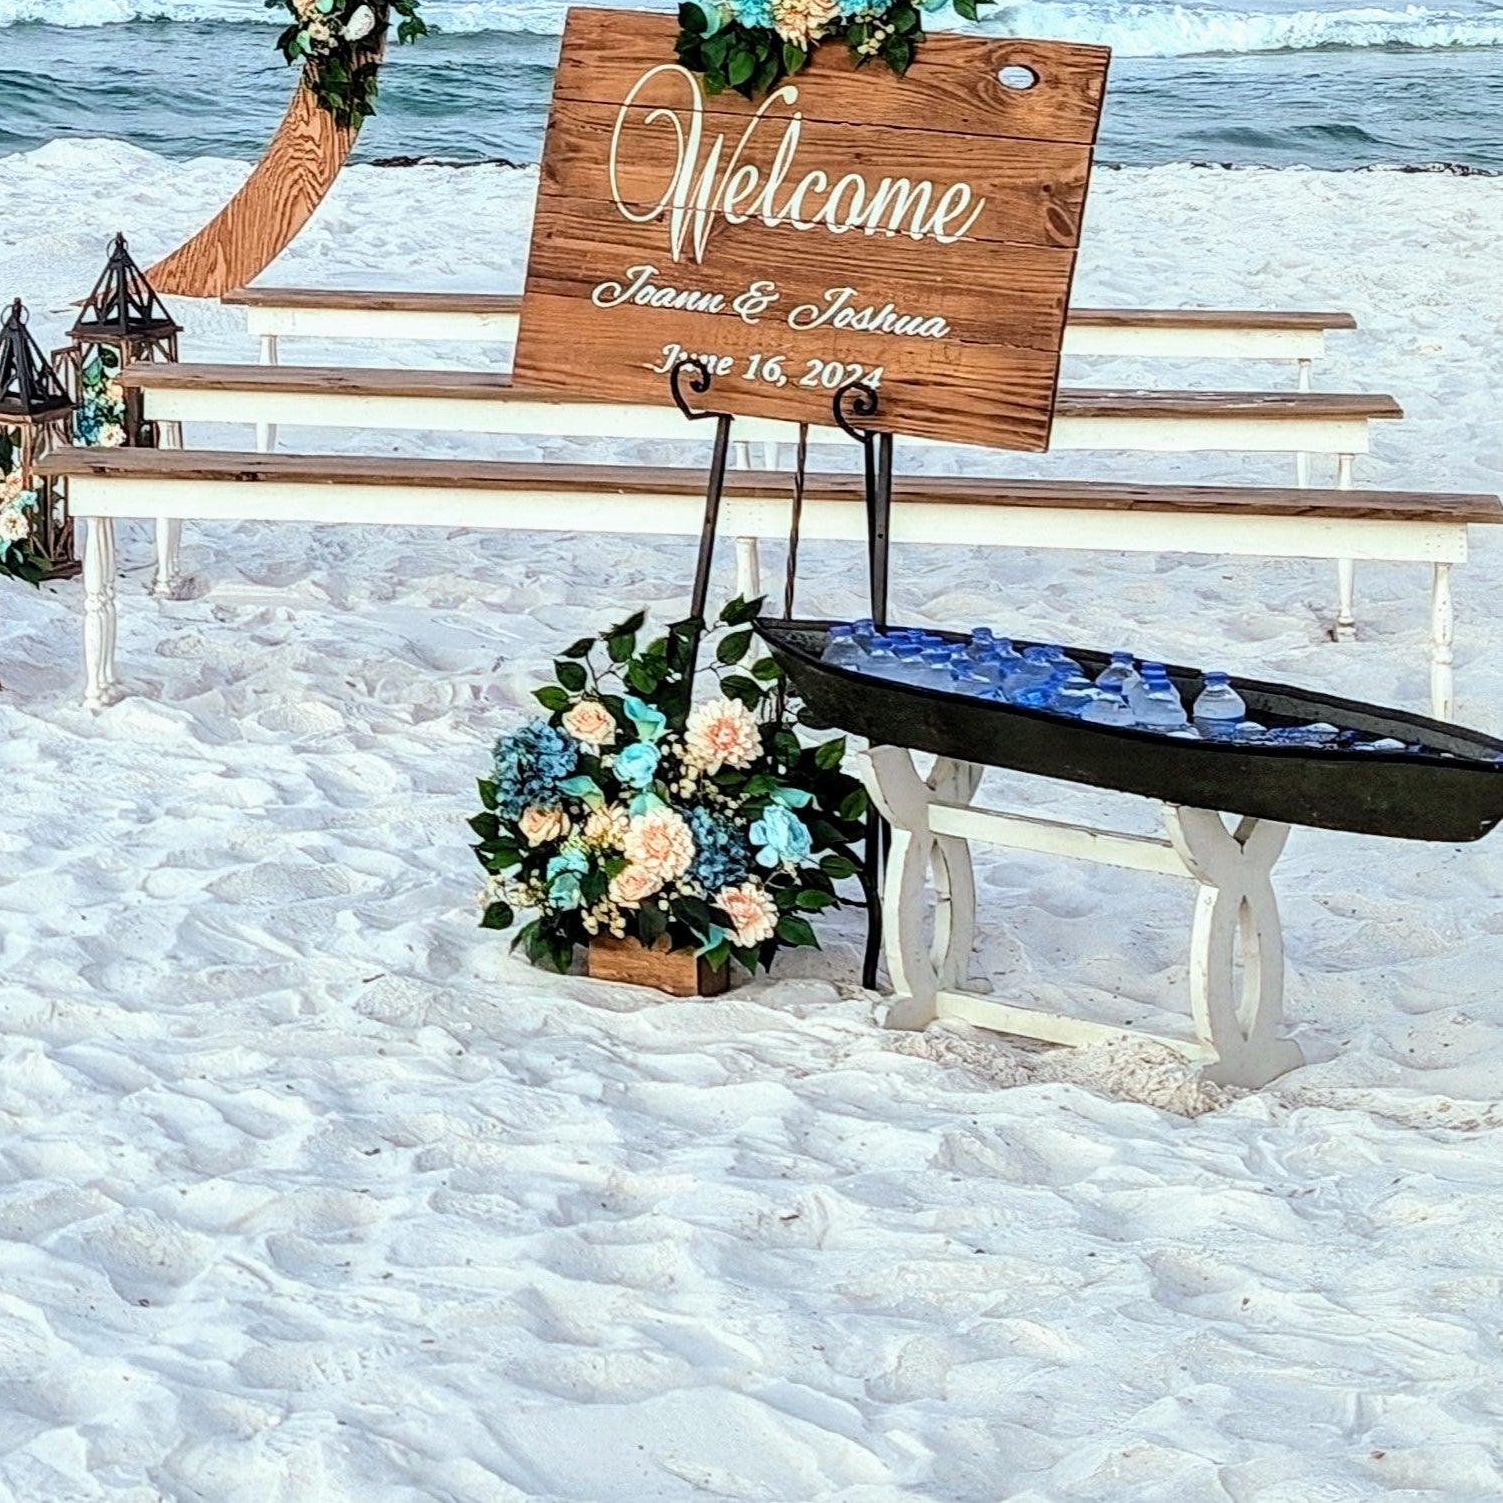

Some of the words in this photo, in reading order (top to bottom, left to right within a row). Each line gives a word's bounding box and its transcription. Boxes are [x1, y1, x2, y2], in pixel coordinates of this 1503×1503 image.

[609, 63, 986, 265] Welcome
[591, 265, 726, 314] Joann
[731, 280, 780, 325] &
[787, 286, 952, 339] Joshua
[742, 353, 787, 387] 16,
[799, 358, 885, 390] 2024
